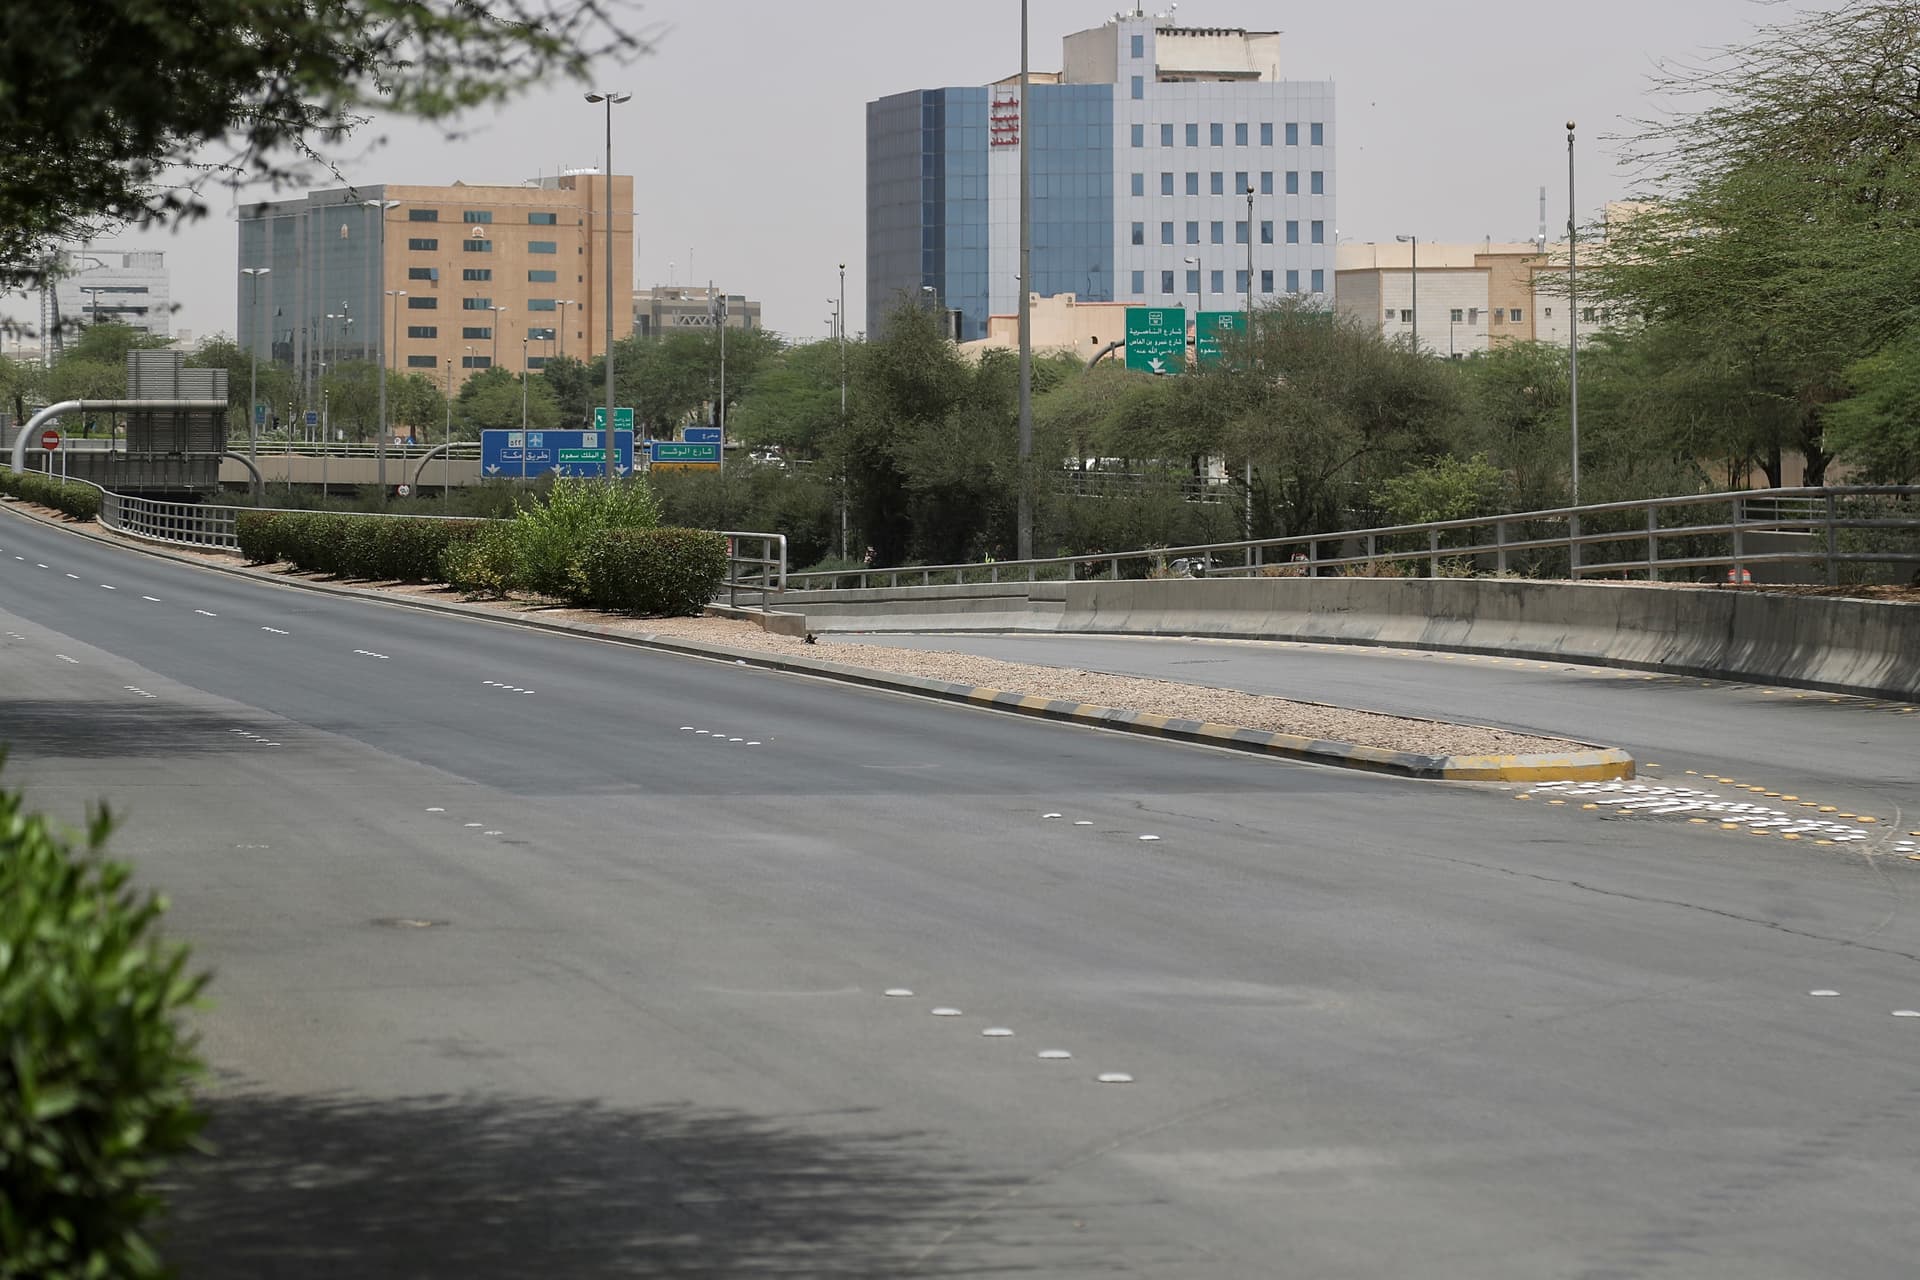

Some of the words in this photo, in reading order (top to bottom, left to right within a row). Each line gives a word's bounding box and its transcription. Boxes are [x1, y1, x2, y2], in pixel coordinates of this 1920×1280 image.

[1164, 328, 1182, 336] شارع
[502, 451, 523, 459] مكة
[526, 450, 549, 461] طريق
[580, 451, 599, 459] الملك
[661, 447, 690, 457] الوشم
[692, 448, 713, 457] شارع
[560, 453, 579, 461] سعود
